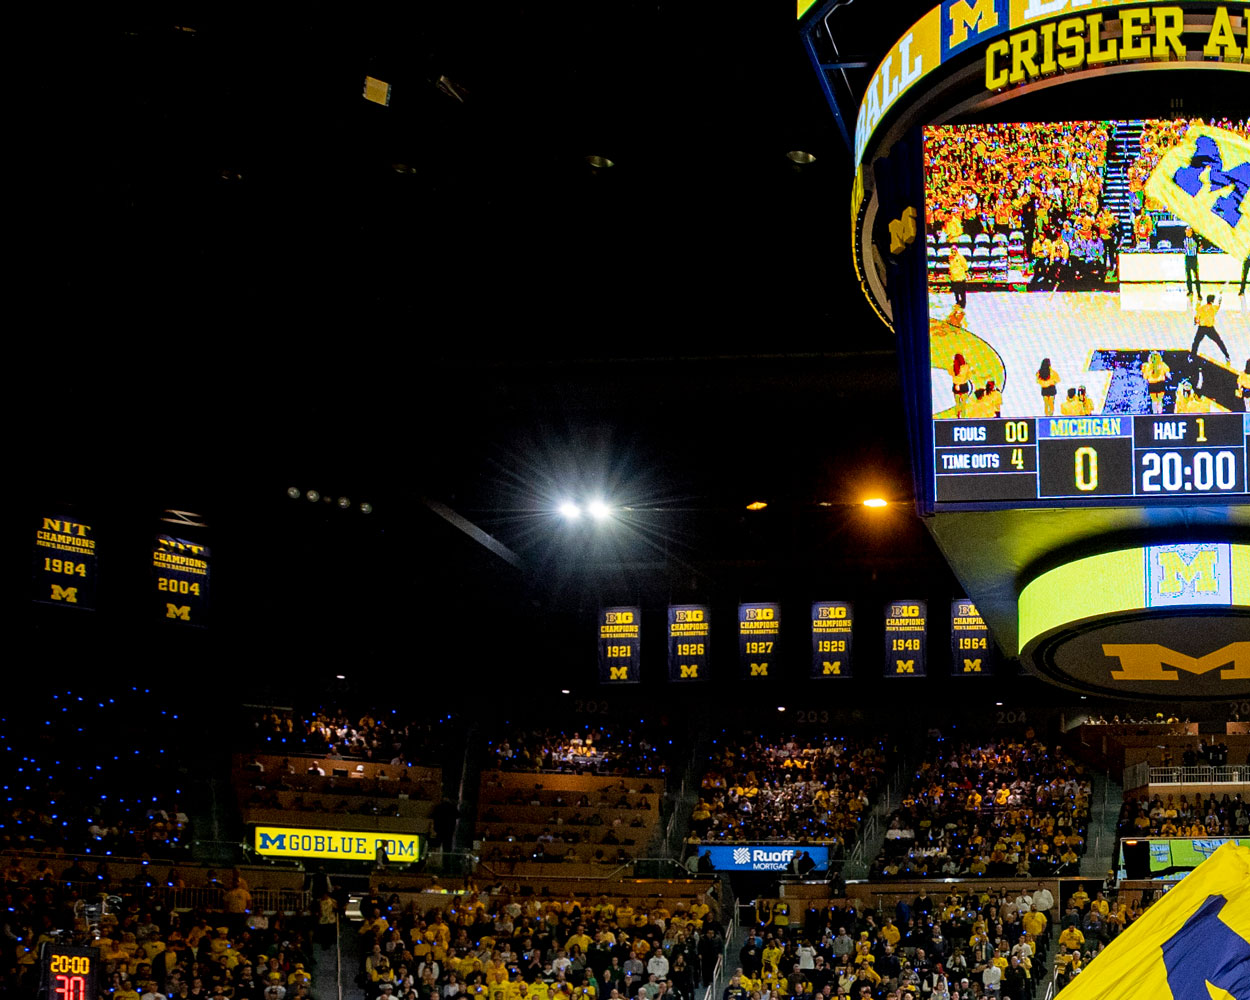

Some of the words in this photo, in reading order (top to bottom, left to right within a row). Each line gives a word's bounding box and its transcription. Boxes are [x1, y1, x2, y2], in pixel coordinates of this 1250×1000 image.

[986, 7, 1186, 91] CRISLER
[953, 427, 986, 442] FOULS
[1005, 421, 1028, 443] 00
[1050, 418, 1121, 437] MICHIGAN
[1154, 422, 1187, 440] HALF
[1196, 418, 1207, 442] 1
[942, 454, 970, 470] TIME
[972, 453, 999, 468] OUTS
[1011, 448, 1024, 470] 4
[1074, 446, 1098, 491] 0
[1142, 451, 1236, 492] 20:00
[42, 517, 91, 537] NIT
[37, 531, 96, 549] CHAMPIONS
[44, 557, 86, 577] 1984
[153, 552, 207, 569] CHAMPIONS
[1158, 550, 1219, 596] M
[158, 577, 200, 596] 2004
[51, 584, 78, 603] M
[166, 603, 191, 621] M
[671, 623, 709, 631] CHAMPIONS
[740, 621, 779, 629] CHAMPIONS
[813, 619, 852, 627] CHAMPIONS
[886, 618, 924, 626] CHAMPIONS
[677, 644, 704, 655] 1926
[746, 642, 773, 654] 1927
[818, 640, 845, 652] 1929
[892, 639, 920, 651] 1948
[959, 638, 987, 650] 1964
[607, 646, 631, 657] 1921
[680, 665, 698, 678] M
[750, 663, 768, 676] M
[823, 661, 840, 674] M
[896, 660, 914, 673] M
[963, 659, 981, 672] M
[610, 667, 627, 680] M
[797, 710, 829, 723] 203
[996, 711, 1026, 723] 204
[753, 850, 793, 862] Ruoff
[51, 955, 90, 974] 20:00
